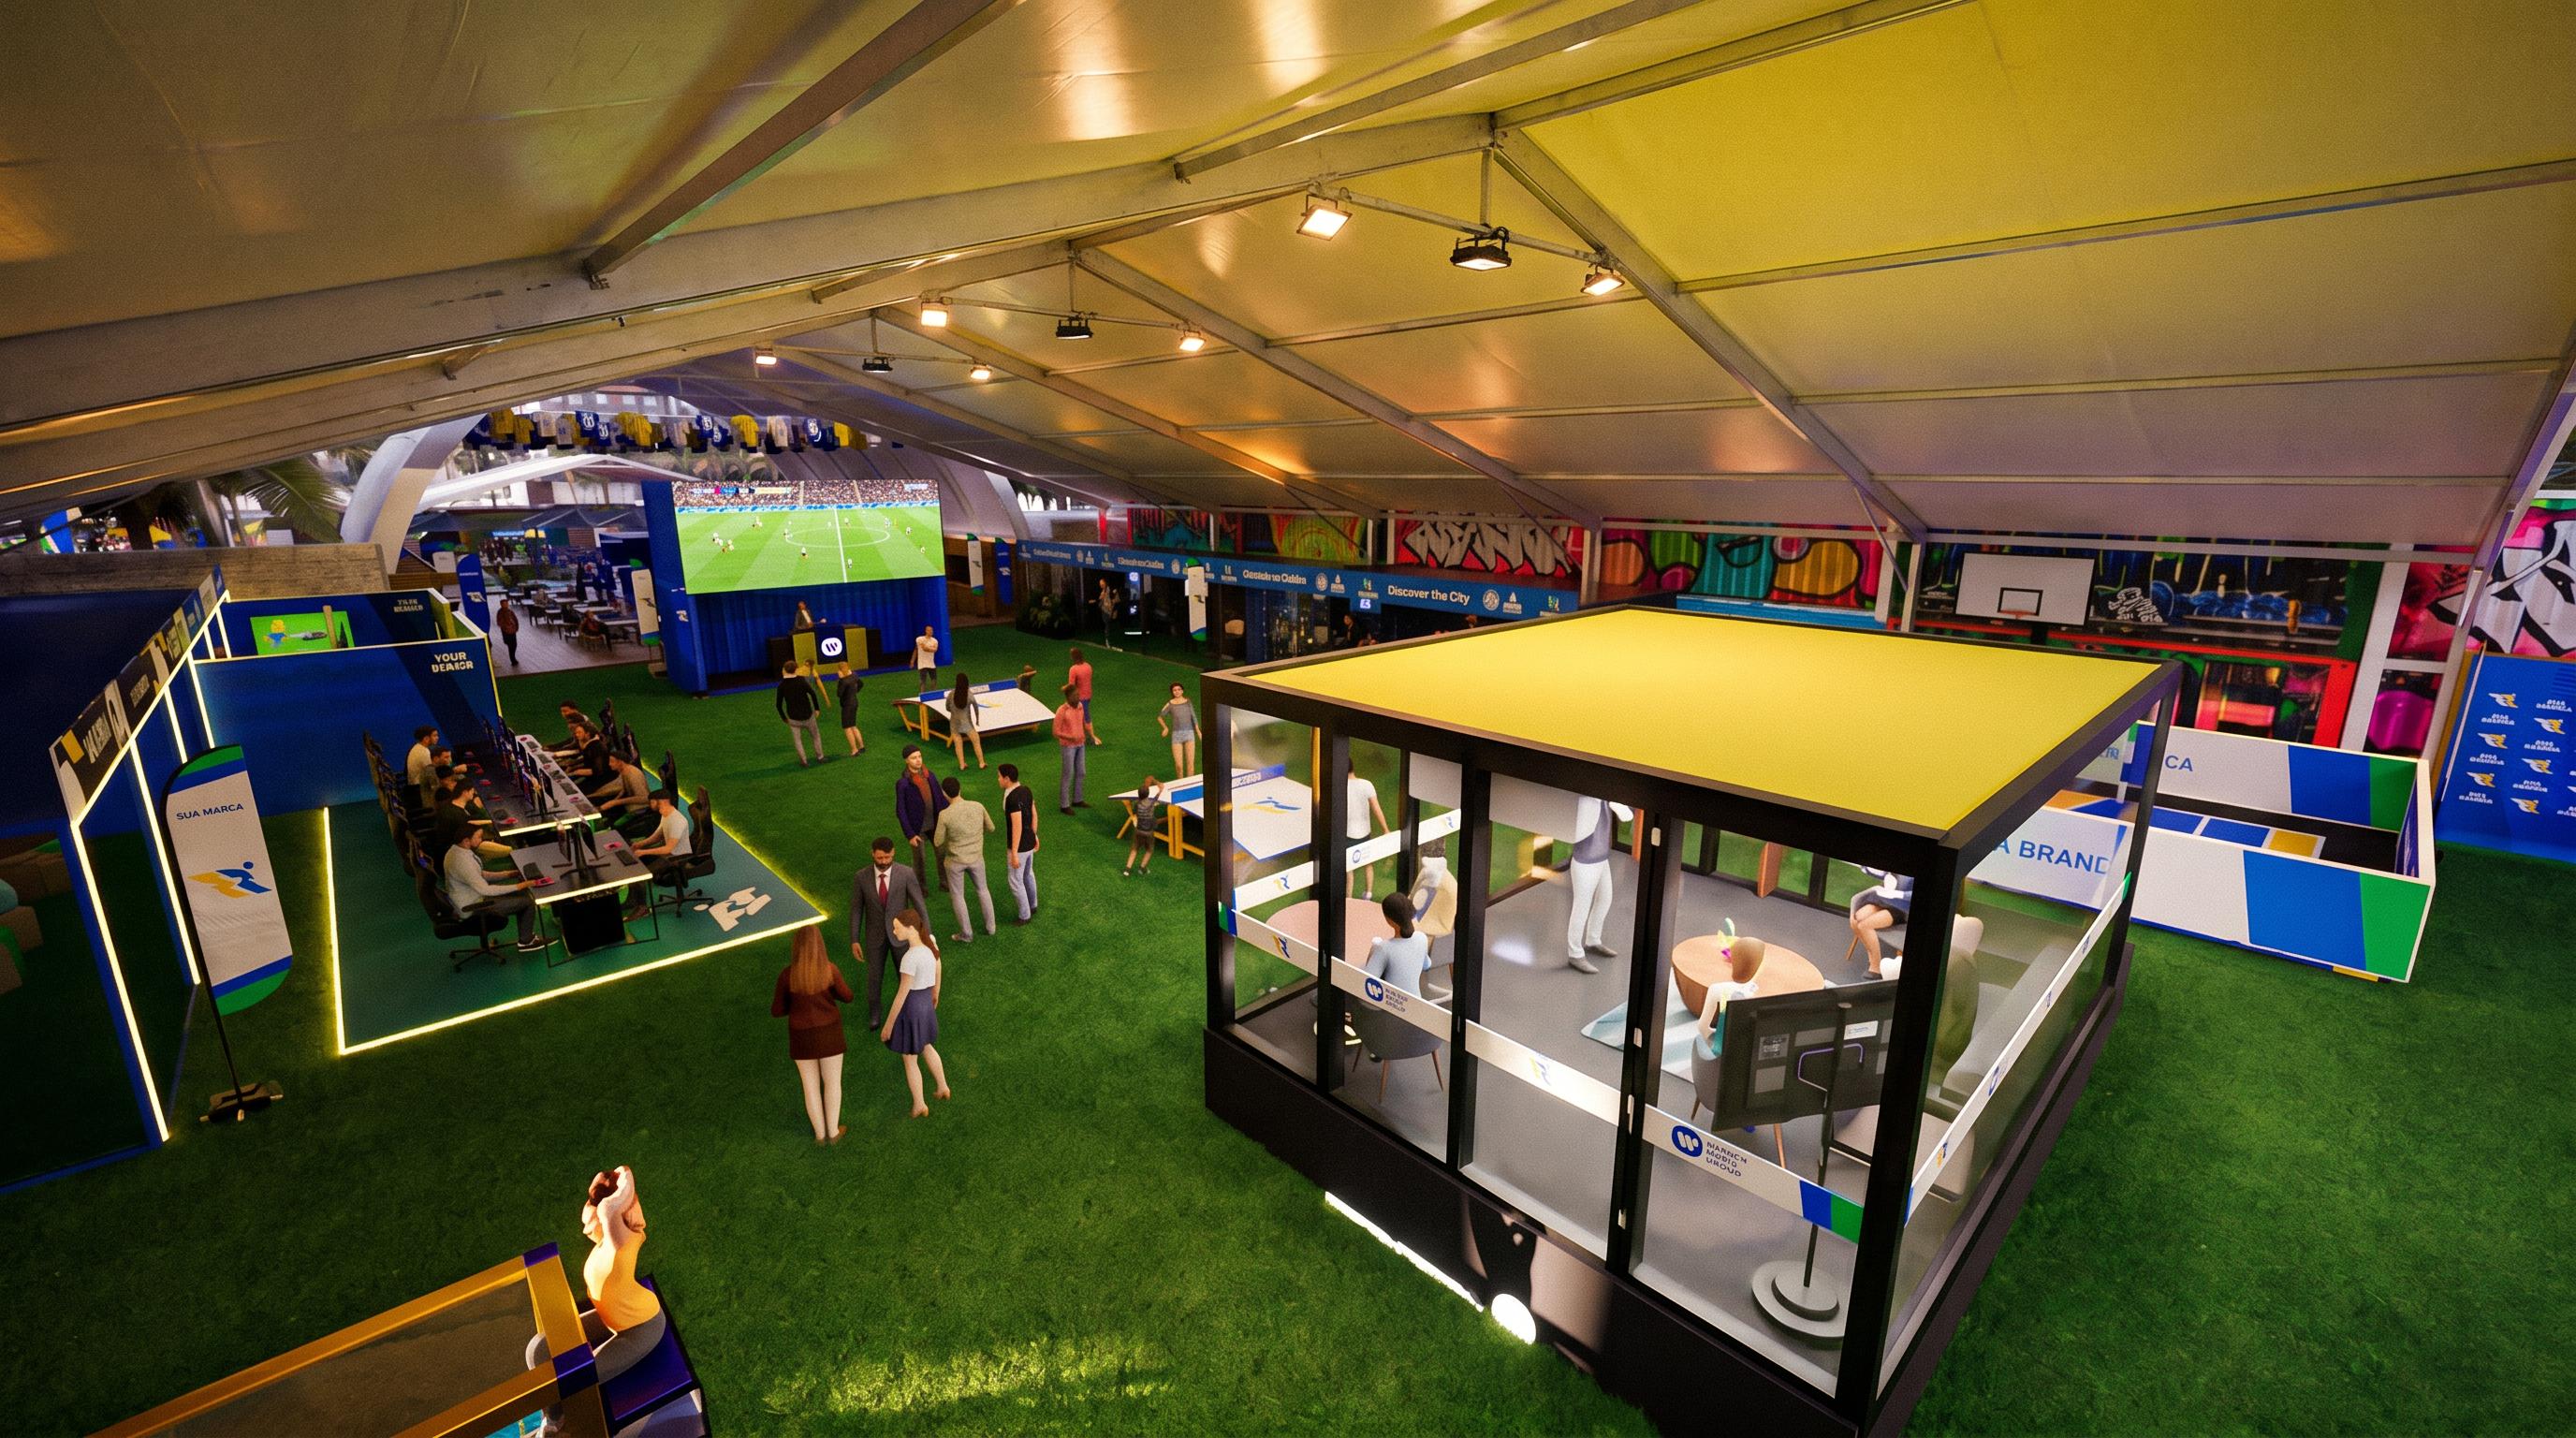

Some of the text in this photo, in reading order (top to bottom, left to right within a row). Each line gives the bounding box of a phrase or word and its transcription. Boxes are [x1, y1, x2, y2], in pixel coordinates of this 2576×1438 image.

[1387, 584, 1429, 599] Discover
[1431, 589, 1448, 601] the
[1449, 591, 1471, 607] City
[434, 652, 467, 664] YOUR
[176, 803, 243, 820] SUA MARCA
[2019, 840, 2111, 875] BRAND
